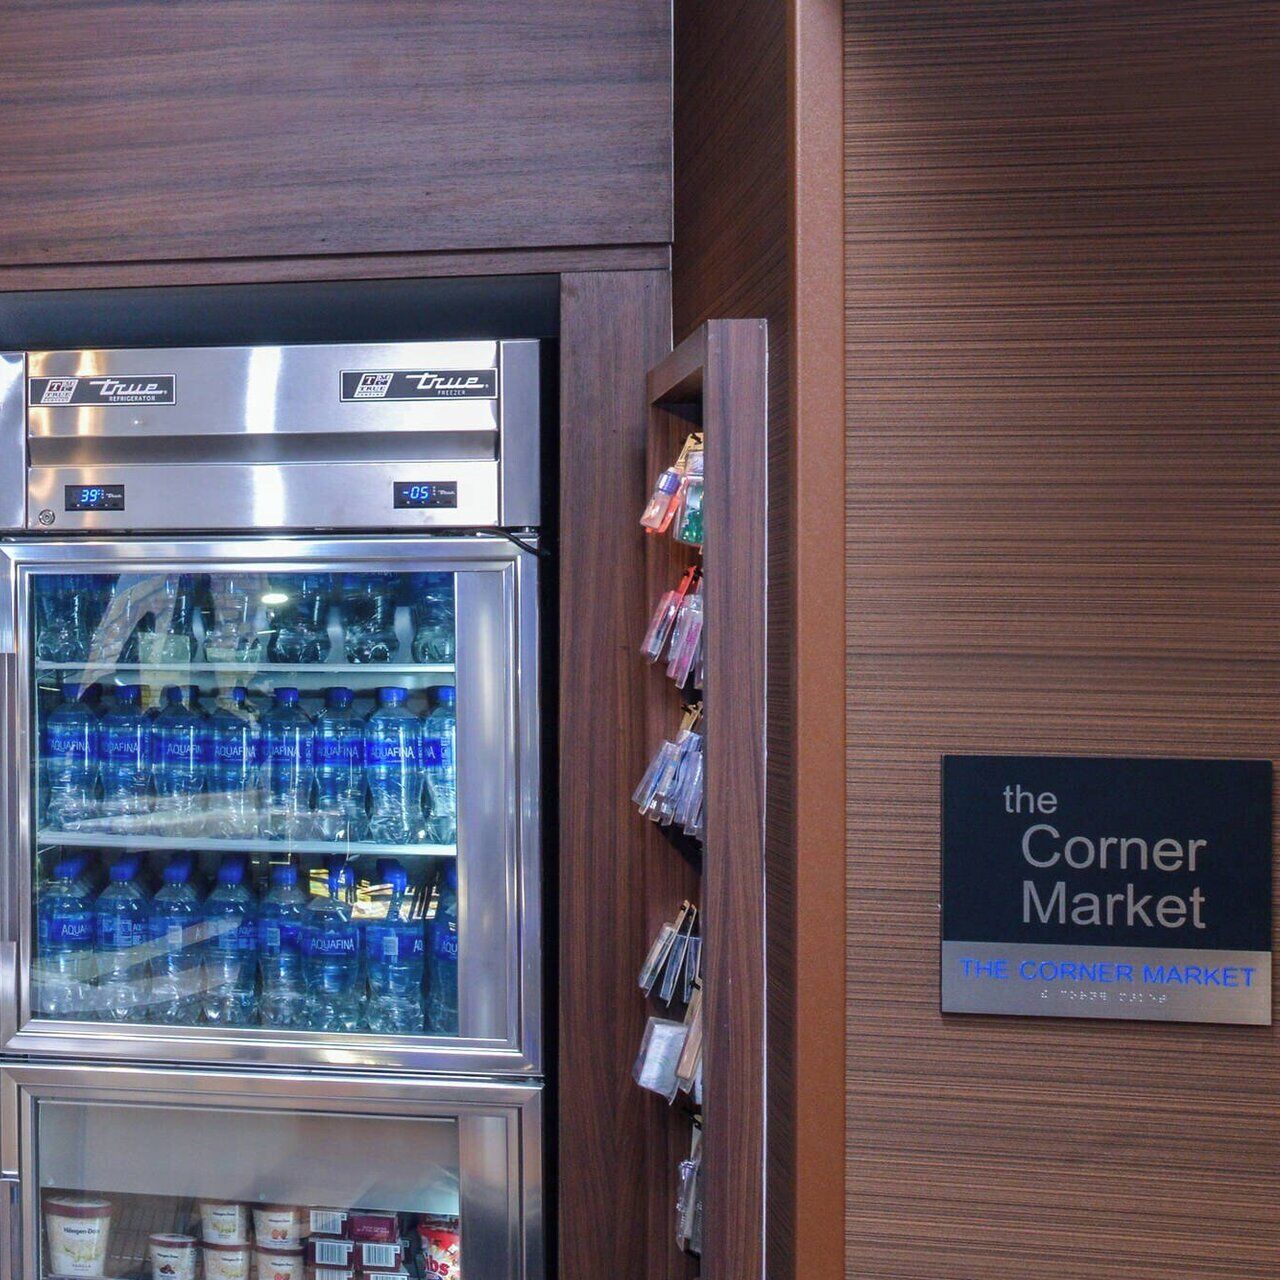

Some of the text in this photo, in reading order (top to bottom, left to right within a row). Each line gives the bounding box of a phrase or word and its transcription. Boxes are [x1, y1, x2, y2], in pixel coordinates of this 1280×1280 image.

[1003, 784, 1058, 814] the
[1022, 824, 1207, 872] Corner
[1022, 880, 1206, 929] Market
[311, 939, 355, 951] AQUAFINA
[960, 958, 1257, 988] THE CORNER MARKET
